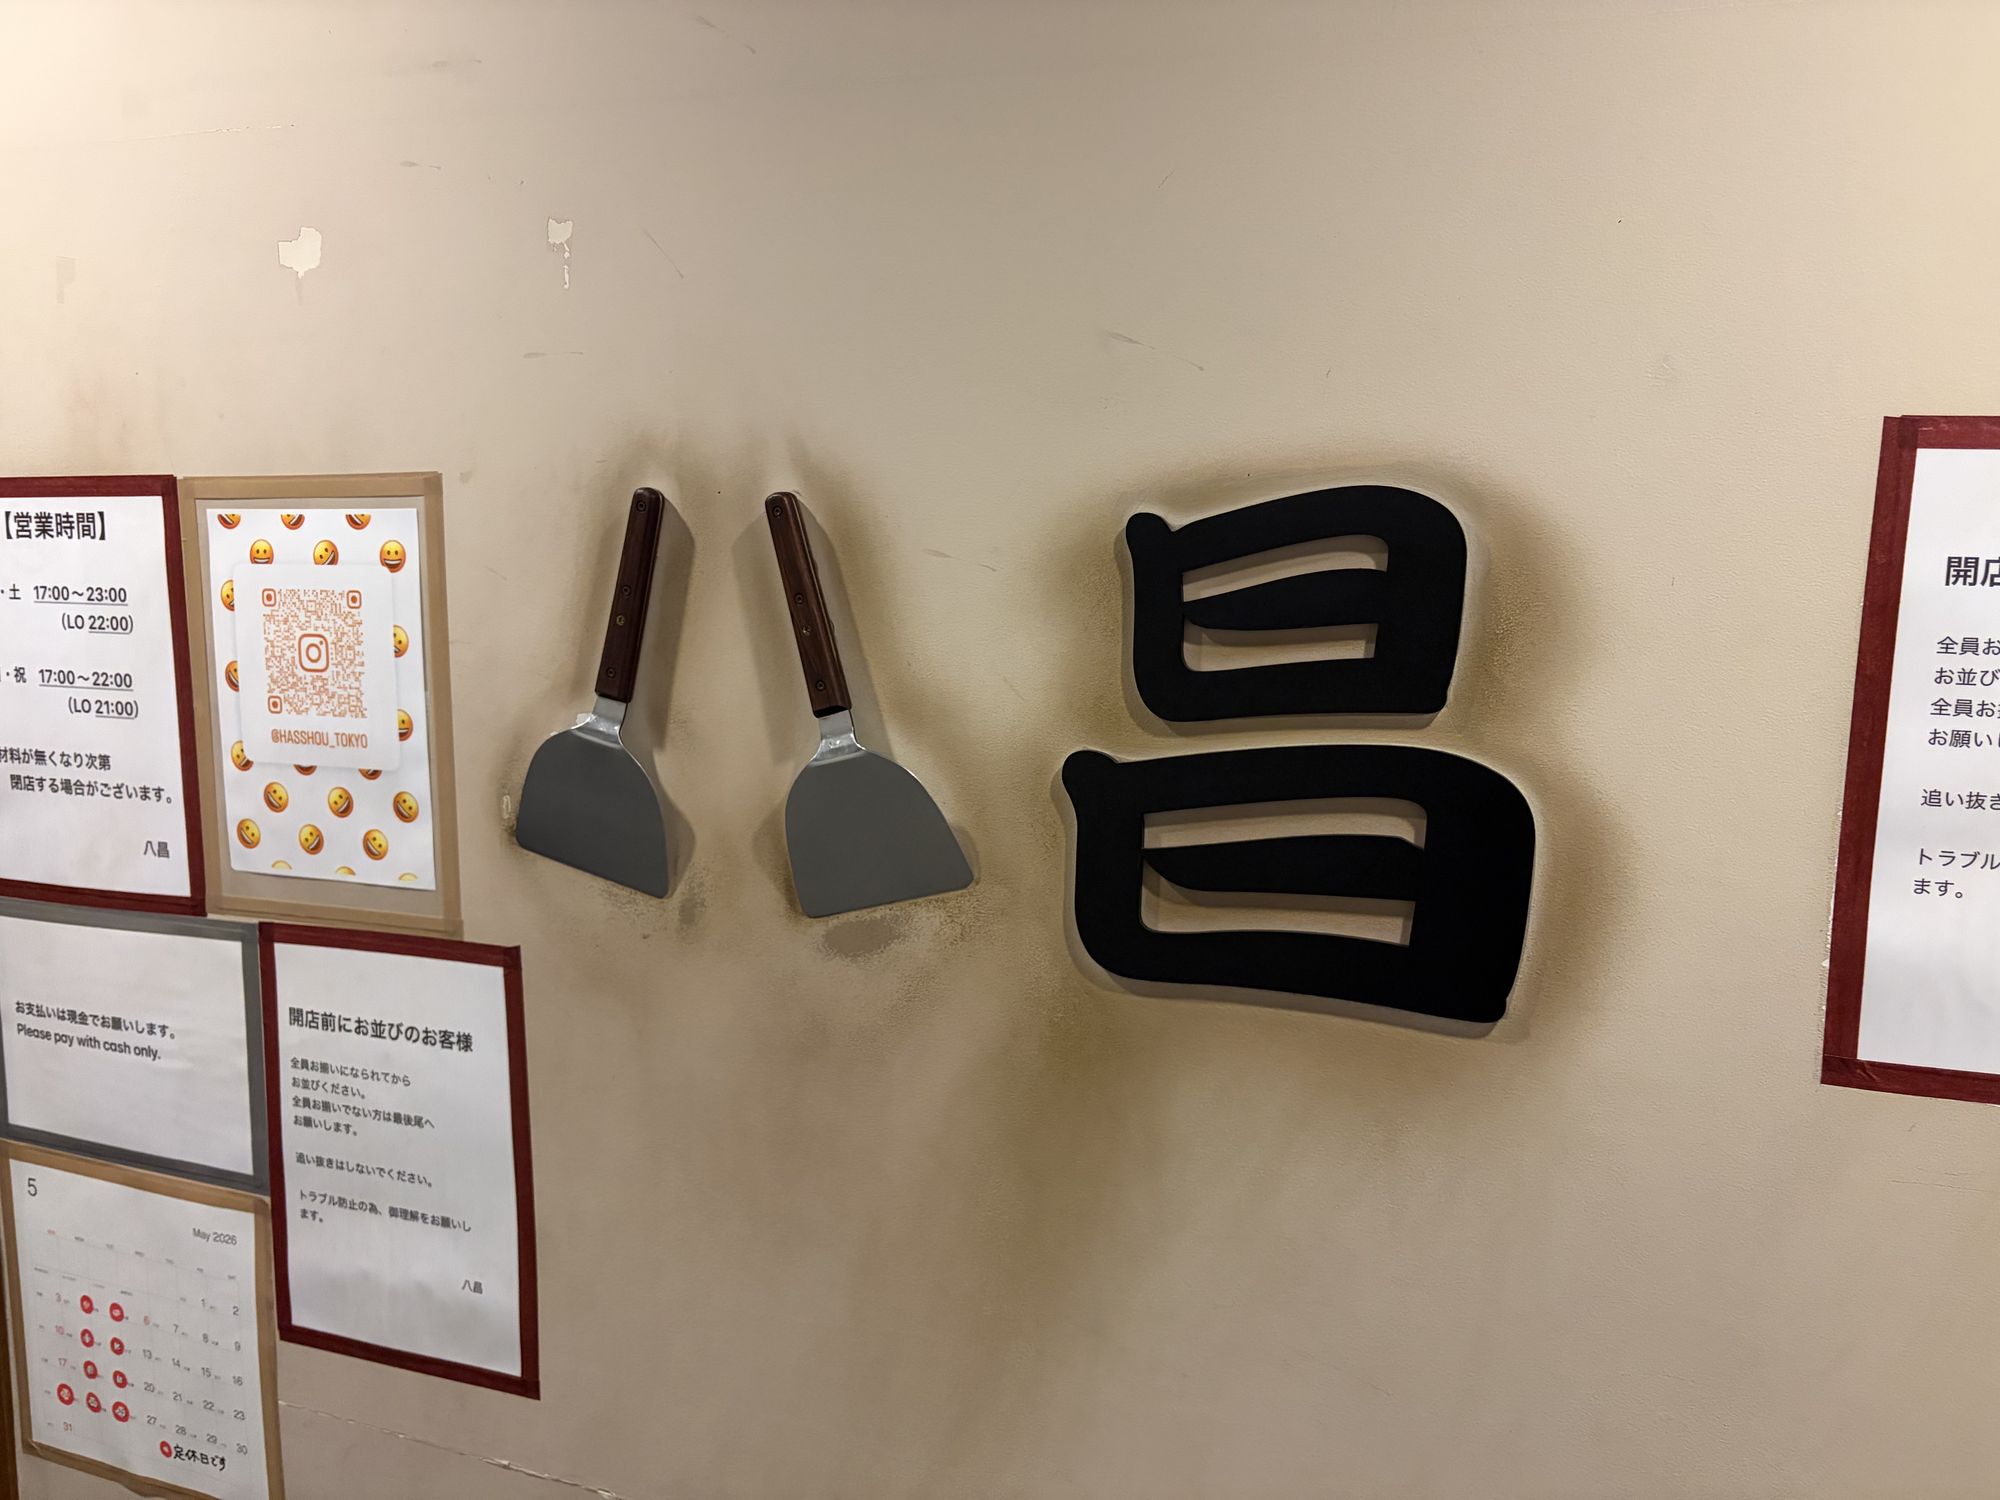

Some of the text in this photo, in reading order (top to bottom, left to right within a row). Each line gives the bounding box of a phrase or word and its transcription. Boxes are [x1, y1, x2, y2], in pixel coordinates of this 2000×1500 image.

[4, 511, 106, 541] 【営業時間】
[61, 612, 134, 635] (LO 22:00)
[1936, 636, 2000, 657] 全員お
[1934, 667, 2000, 687] お並び
[68, 696, 139, 719] (LO 21:00)
[1930, 698, 2000, 719] 全員お
[271, 728, 368, 749] @HASSHOU_TOKYO
[1928, 728, 2000, 749] お願い
[10, 774, 172, 804] 閉店する場合がございます。
[143, 840, 170, 859] 八昌
[1919, 848, 2000, 871] トラブル
[1913, 878, 1964, 899] ます。
[15, 1001, 176, 1039] お支払いは現金でお願いします。
[289, 1006, 473, 1052] 開店前にお並びのお客様
[17, 1023, 161, 1061] Please pay with cash only.
[291, 1077, 366, 1100] お並びください。
[293, 1115, 358, 1136] お願いします。
[295, 1152, 433, 1187] 追い抜きはしないでください。
[27, 1177, 38, 1197] 5
[300, 1208, 324, 1224] ます。
[192, 1227, 238, 1246] May 2026
[461, 1279, 483, 1295] 八昌
[232, 1305, 240, 1317] 2
[172, 1323, 179, 1334] 7
[142, 1348, 153, 1360] 13
[201, 1366, 212, 1378] 15
[232, 1375, 243, 1387] 16
[58, 1357, 68, 1367] 17
[143, 1381, 156, 1393] 20
[172, 1391, 183, 1402] 21
[202, 1399, 215, 1412] 22
[233, 1409, 246, 1421] 23
[63, 1421, 73, 1432] 31
[146, 1415, 157, 1426] 27
[175, 1424, 187, 1436] 28
[206, 1432, 218, 1445] 29
[236, 1443, 248, 1456] 30
[173, 1443, 226, 1471] 定休日です
